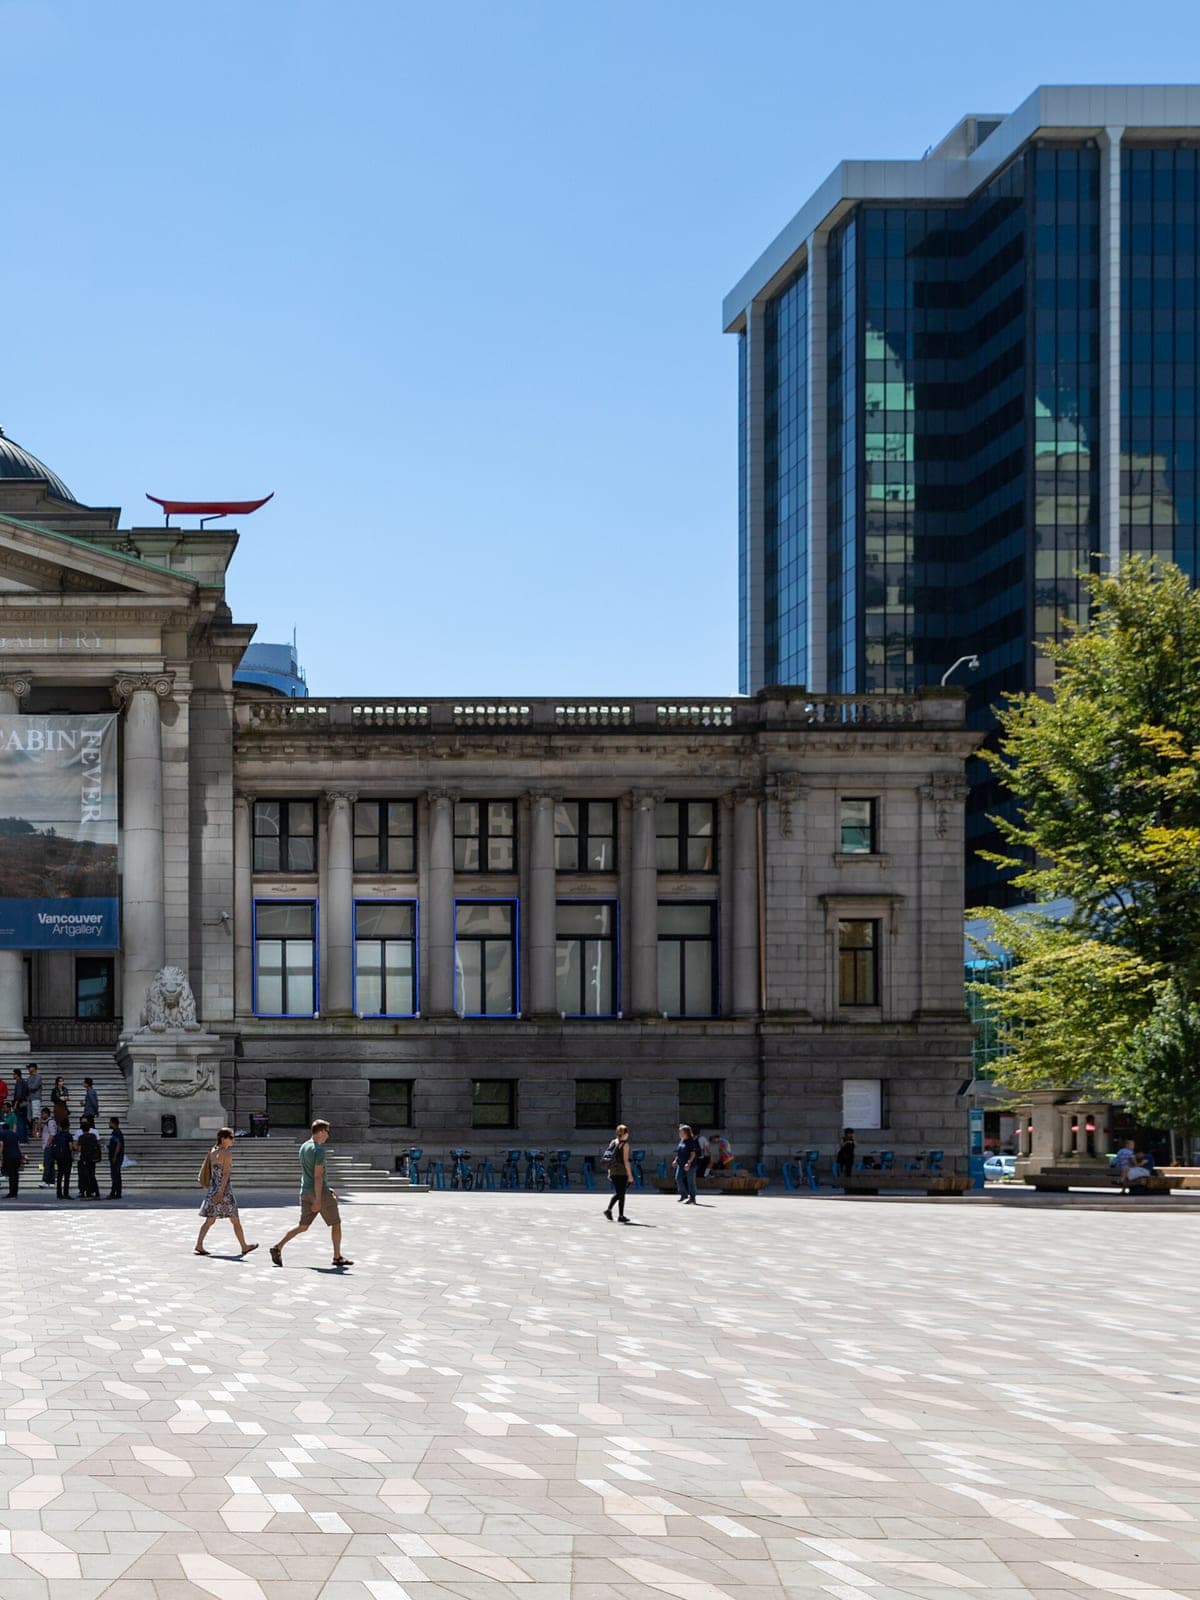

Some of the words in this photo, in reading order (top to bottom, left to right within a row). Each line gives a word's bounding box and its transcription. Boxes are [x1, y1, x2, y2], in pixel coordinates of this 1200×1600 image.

[80, 729, 102, 825] FEVER
[37, 912, 103, 924] Vancouver
[52, 924, 103, 937] Artgallery
